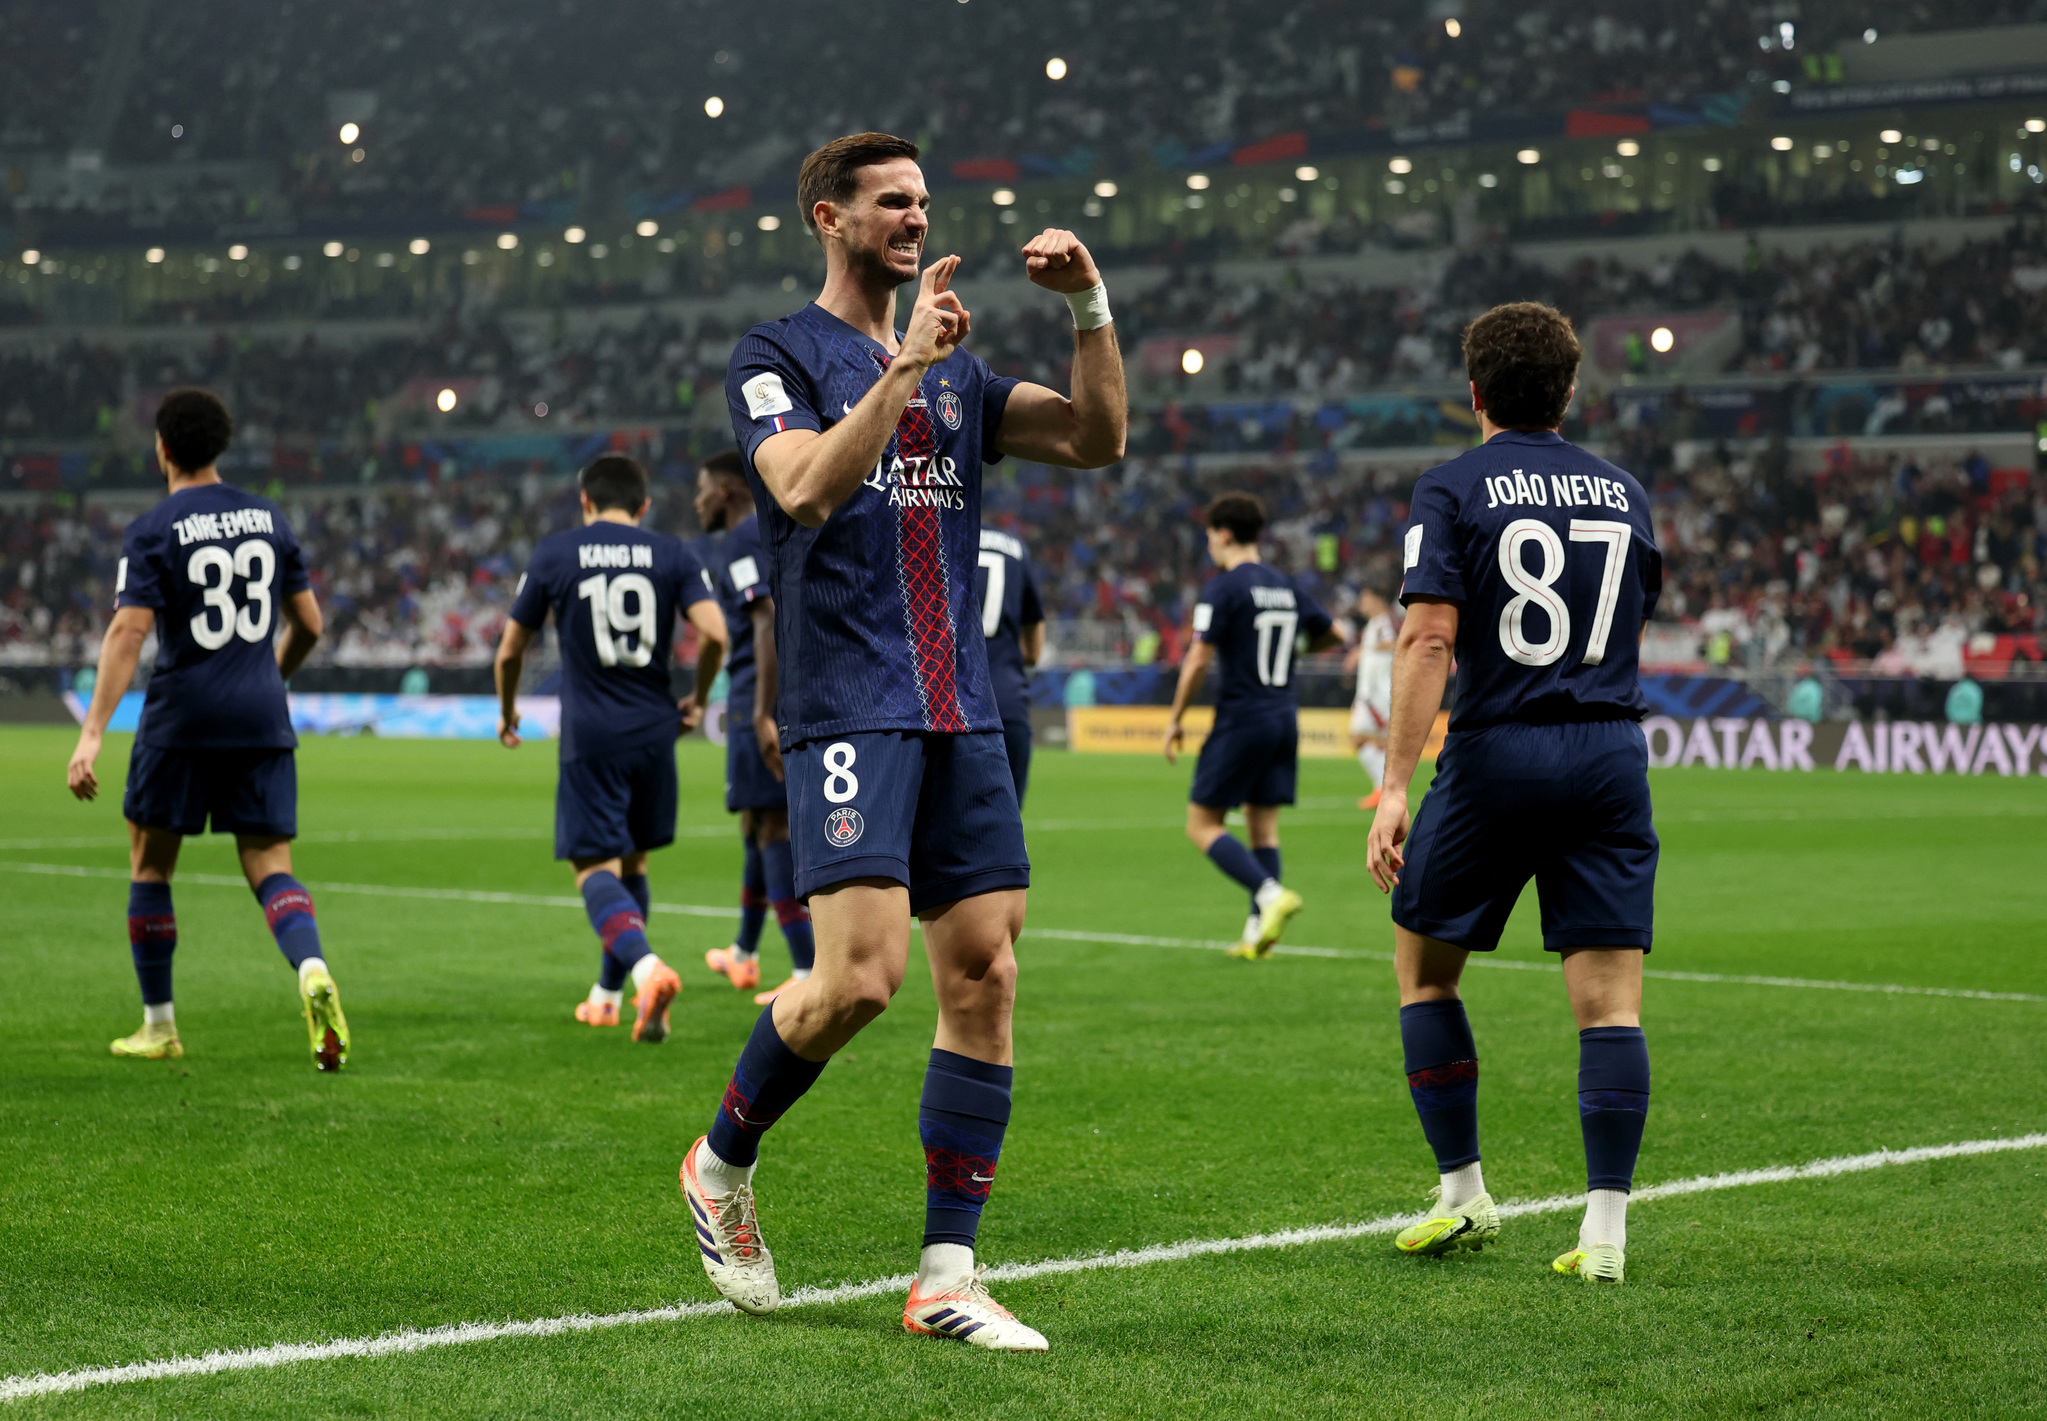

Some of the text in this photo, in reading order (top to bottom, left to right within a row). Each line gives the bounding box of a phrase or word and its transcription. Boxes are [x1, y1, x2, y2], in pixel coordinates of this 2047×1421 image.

[940, 393, 958, 405] PARIS
[888, 486, 965, 510] AIRWAYS
[1485, 469, 1629, 513] JOÃO NEVES
[172, 507, 274, 546] ZAÏRE-EMERY
[579, 543, 653, 569] KANG IN
[187, 538, 276, 650] 33
[1499, 518, 1632, 667] 87
[578, 572, 657, 668] 19
[1253, 609, 1299, 687] 17
[823, 742, 858, 803] 8
[830, 809, 857, 821] PARIS
